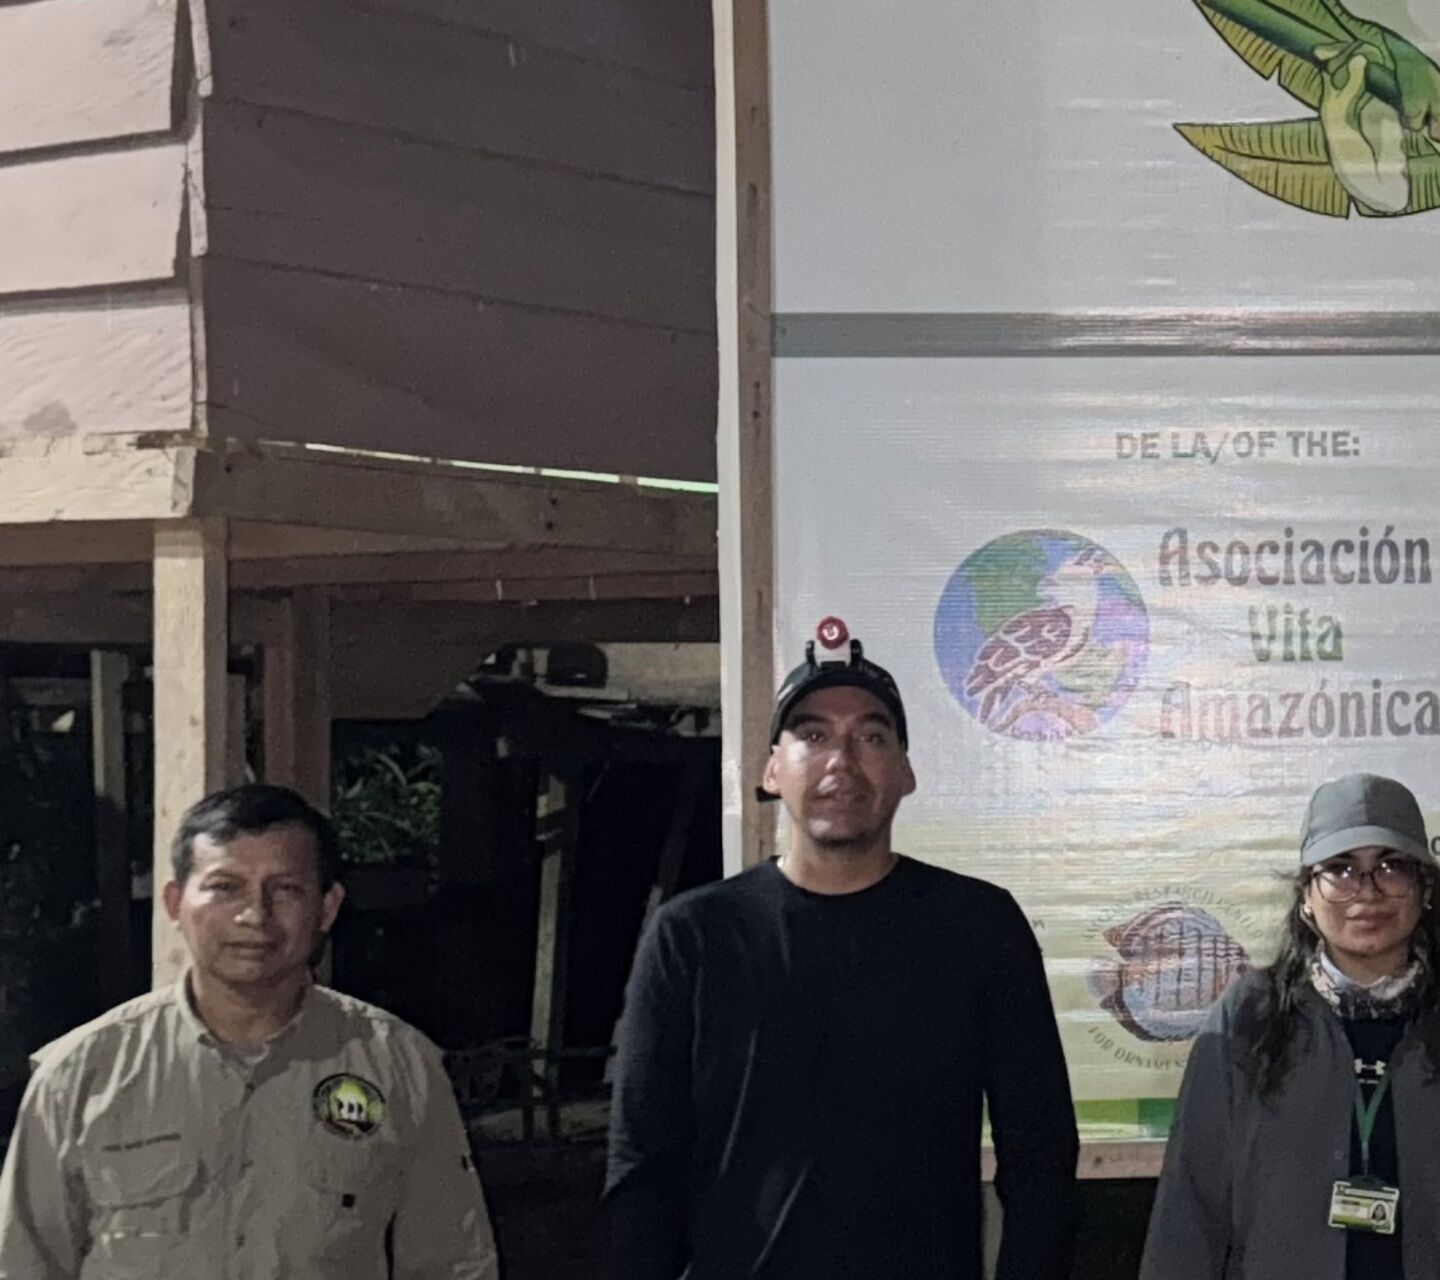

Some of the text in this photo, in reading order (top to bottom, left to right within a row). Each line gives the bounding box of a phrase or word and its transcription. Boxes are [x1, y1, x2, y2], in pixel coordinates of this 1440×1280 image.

[1115, 430, 1361, 465] DE LA/OF THE:
[1159, 525, 1433, 587] Asociación
[1248, 602, 1344, 662] Vita
